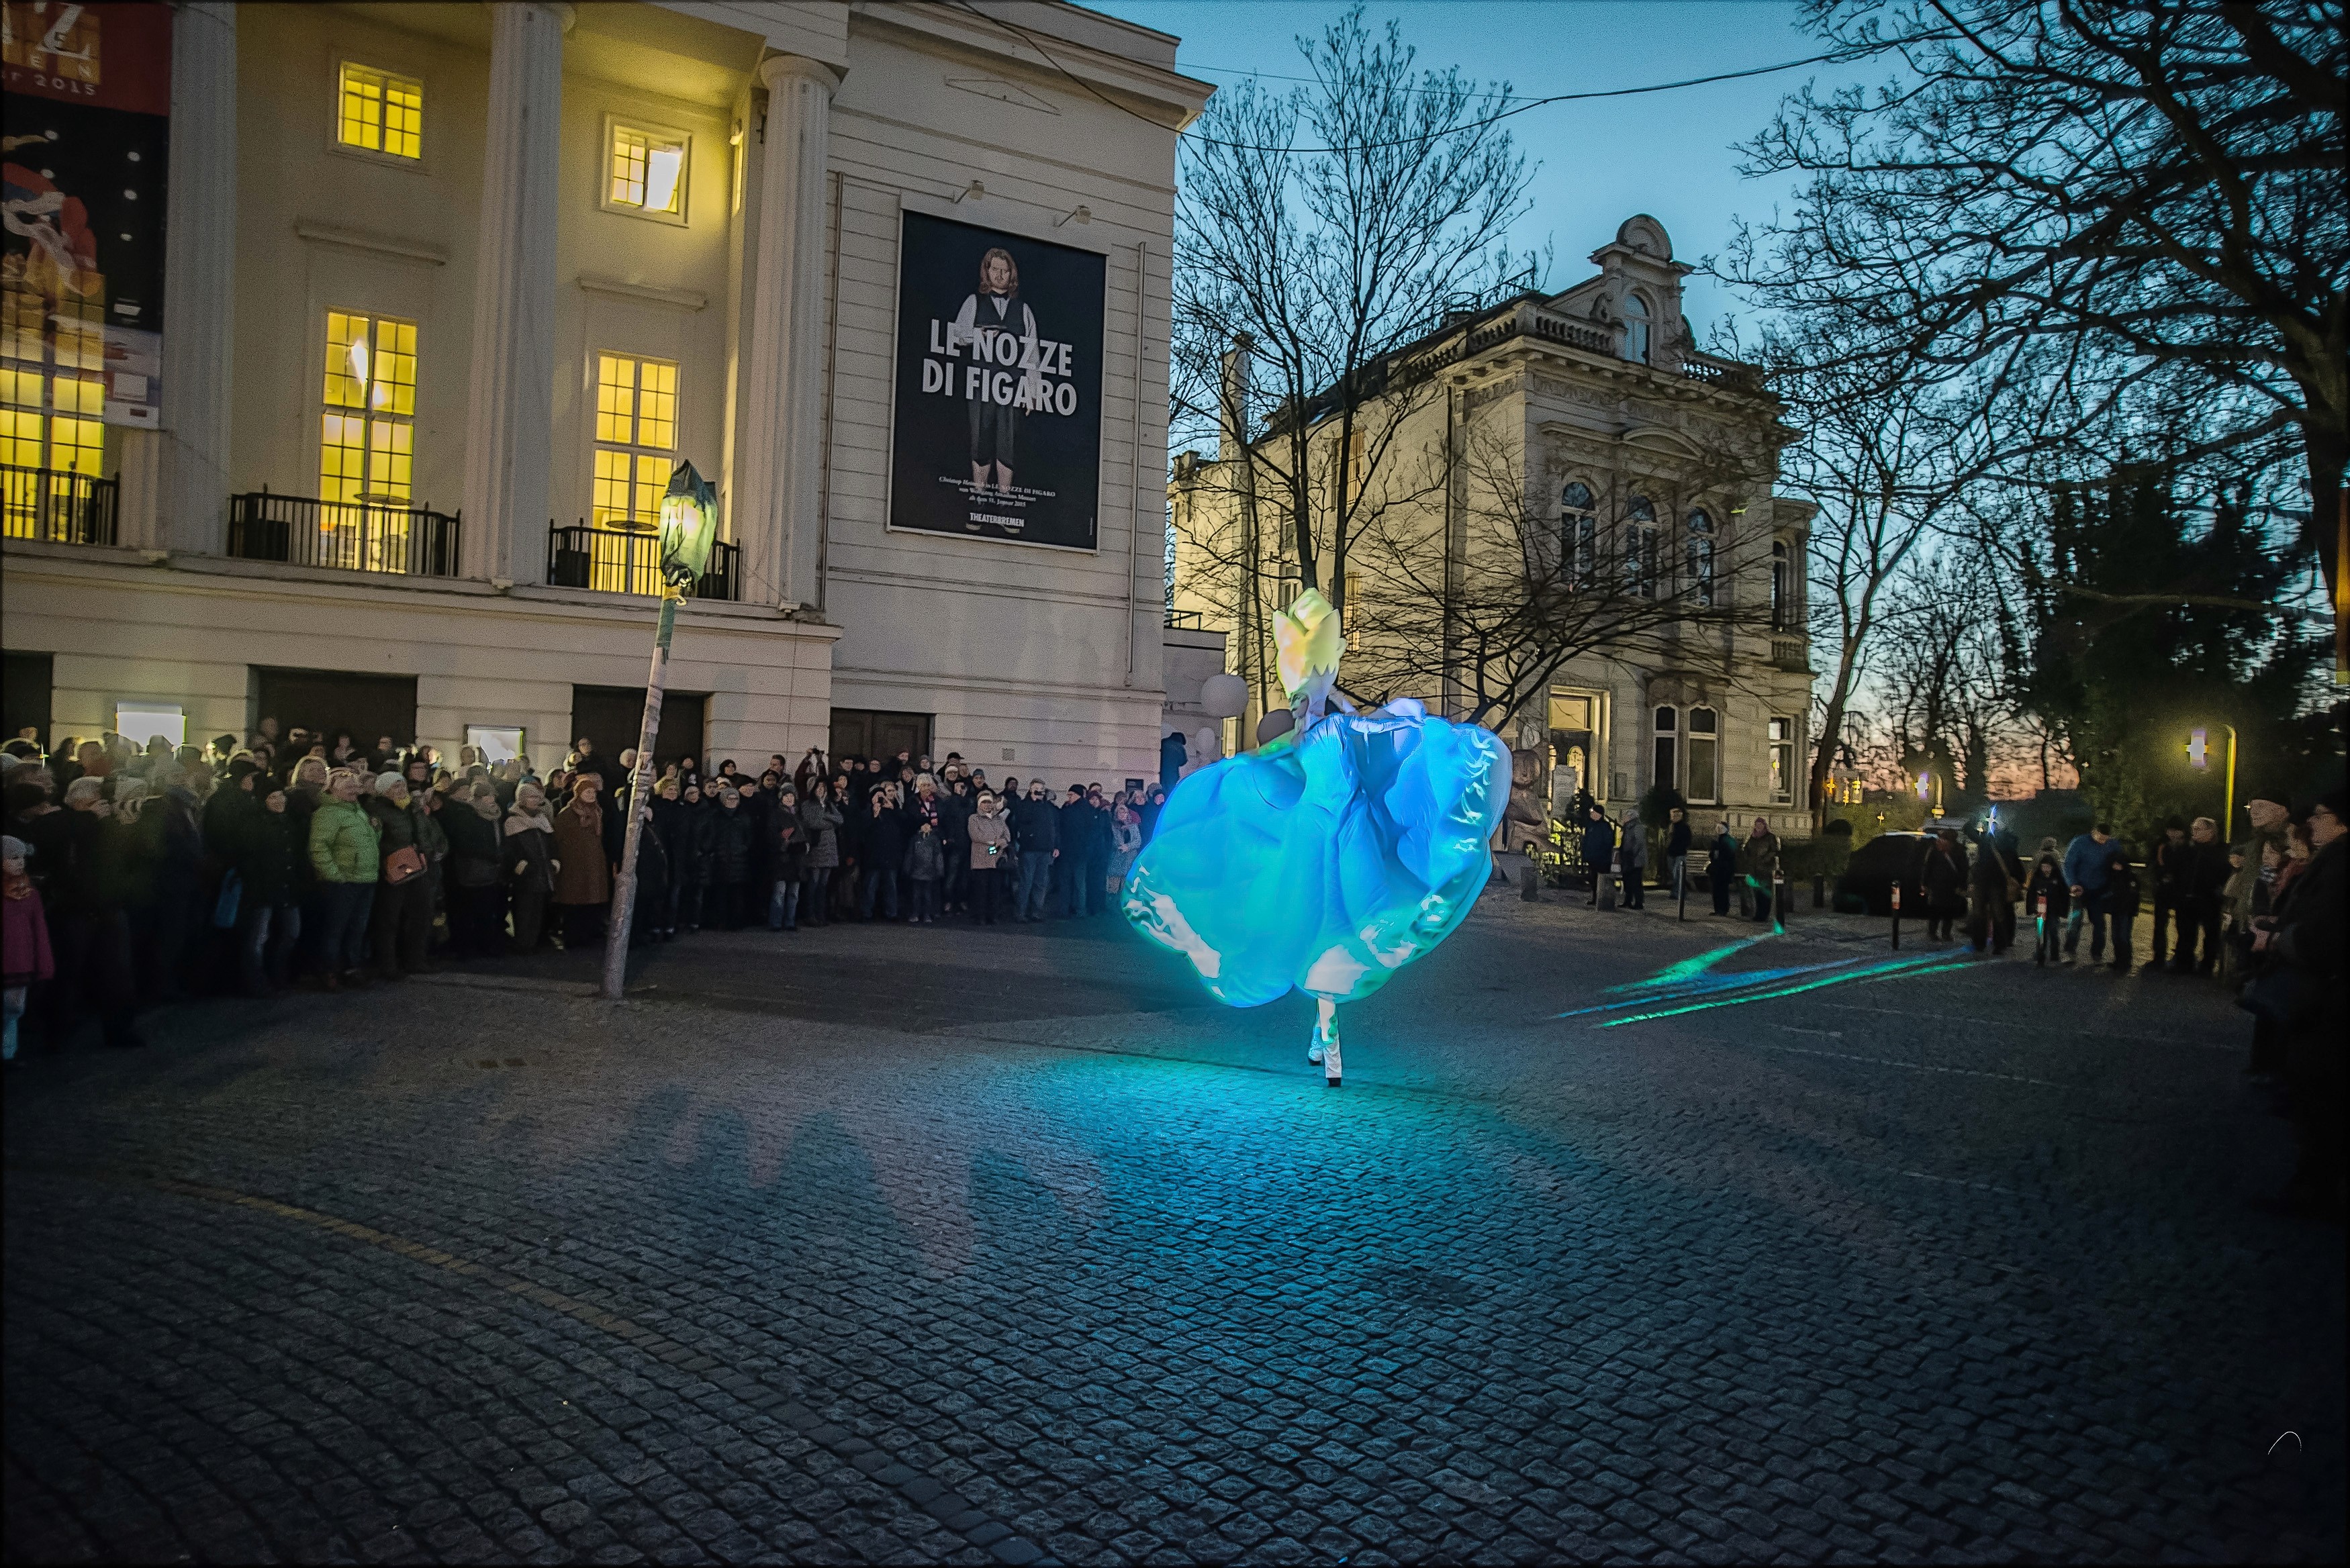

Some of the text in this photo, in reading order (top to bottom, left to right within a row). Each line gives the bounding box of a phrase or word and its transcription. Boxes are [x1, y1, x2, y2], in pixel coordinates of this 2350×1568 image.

[34, 73, 96, 96] 2015
[930, 318, 1073, 377] LE NOZZE
[923, 358, 1078, 416] DI FIGARO
[970, 512, 1025, 528] THEATERBREMEN
